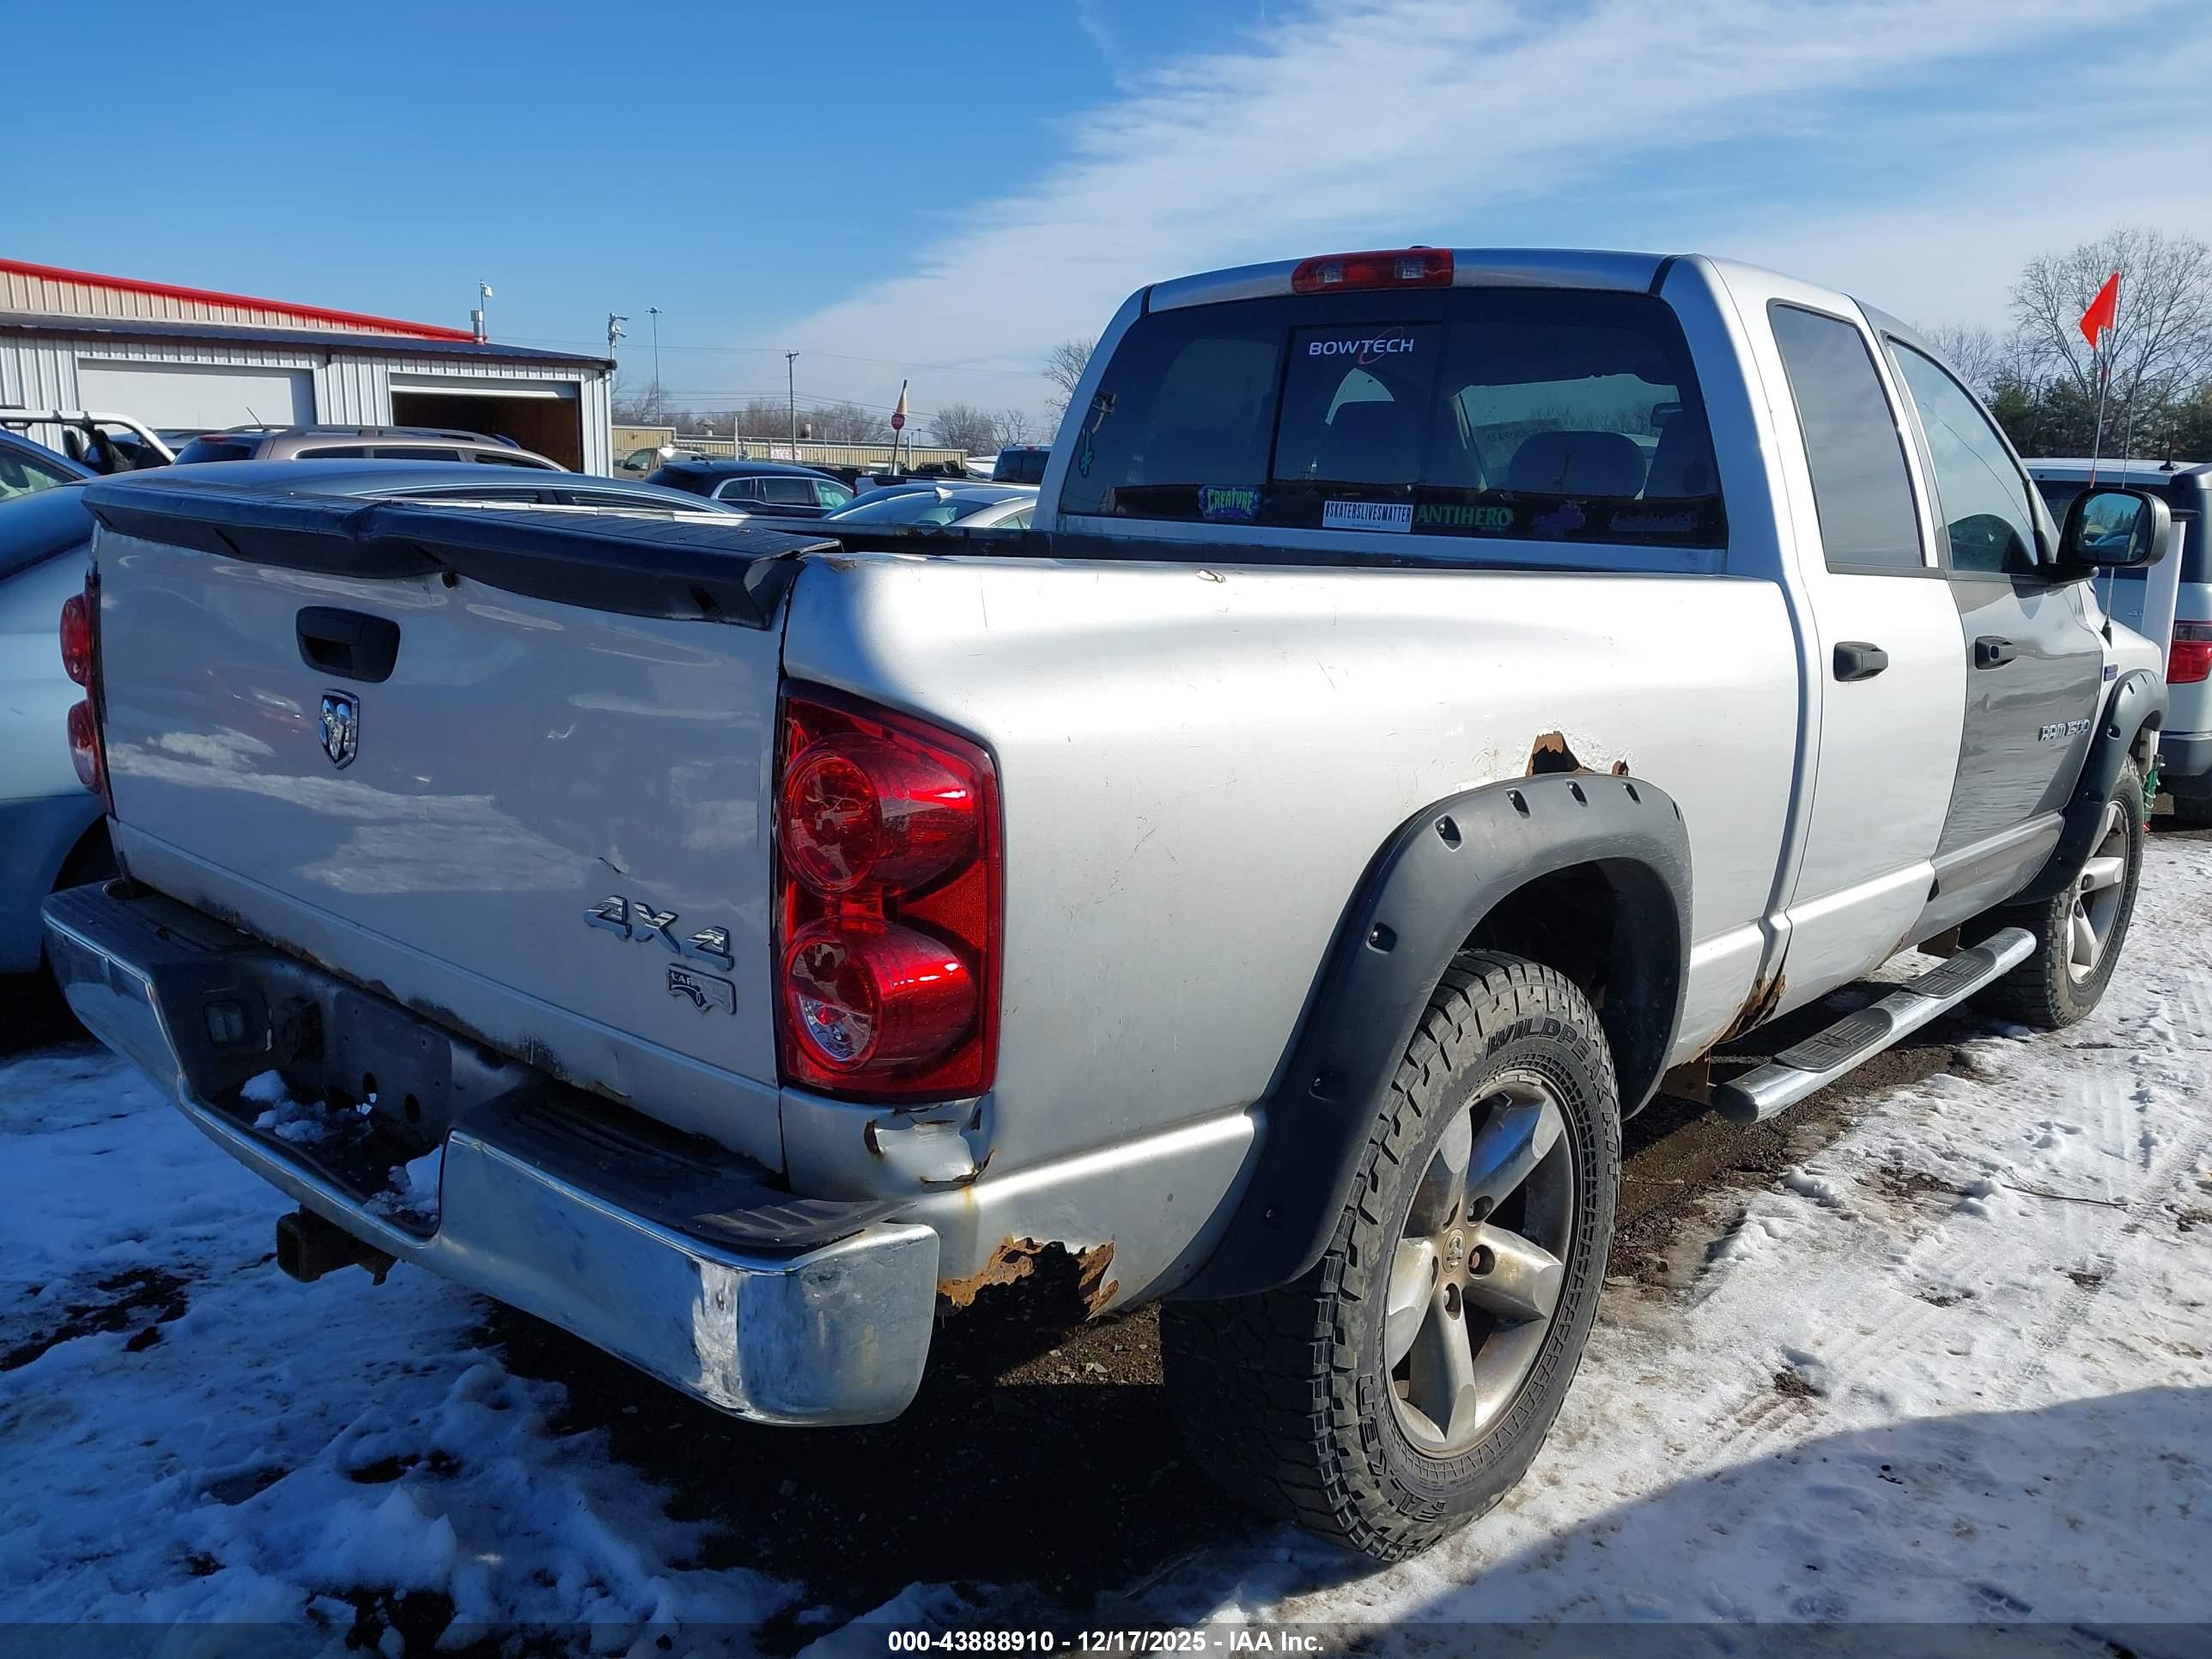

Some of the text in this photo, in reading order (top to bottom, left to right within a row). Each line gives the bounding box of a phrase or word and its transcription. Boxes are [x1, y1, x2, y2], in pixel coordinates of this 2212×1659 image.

[1309, 339, 1414, 356] BOWTECH
[1206, 489, 1255, 515] CREATURE
[1325, 501, 1412, 523] #SKATERSLIVESMATTER
[1416, 503, 1513, 526] ANTIHERO
[2039, 719, 2091, 742] RAM 1500
[1485, 1017, 1610, 1105] WILDPEAK
